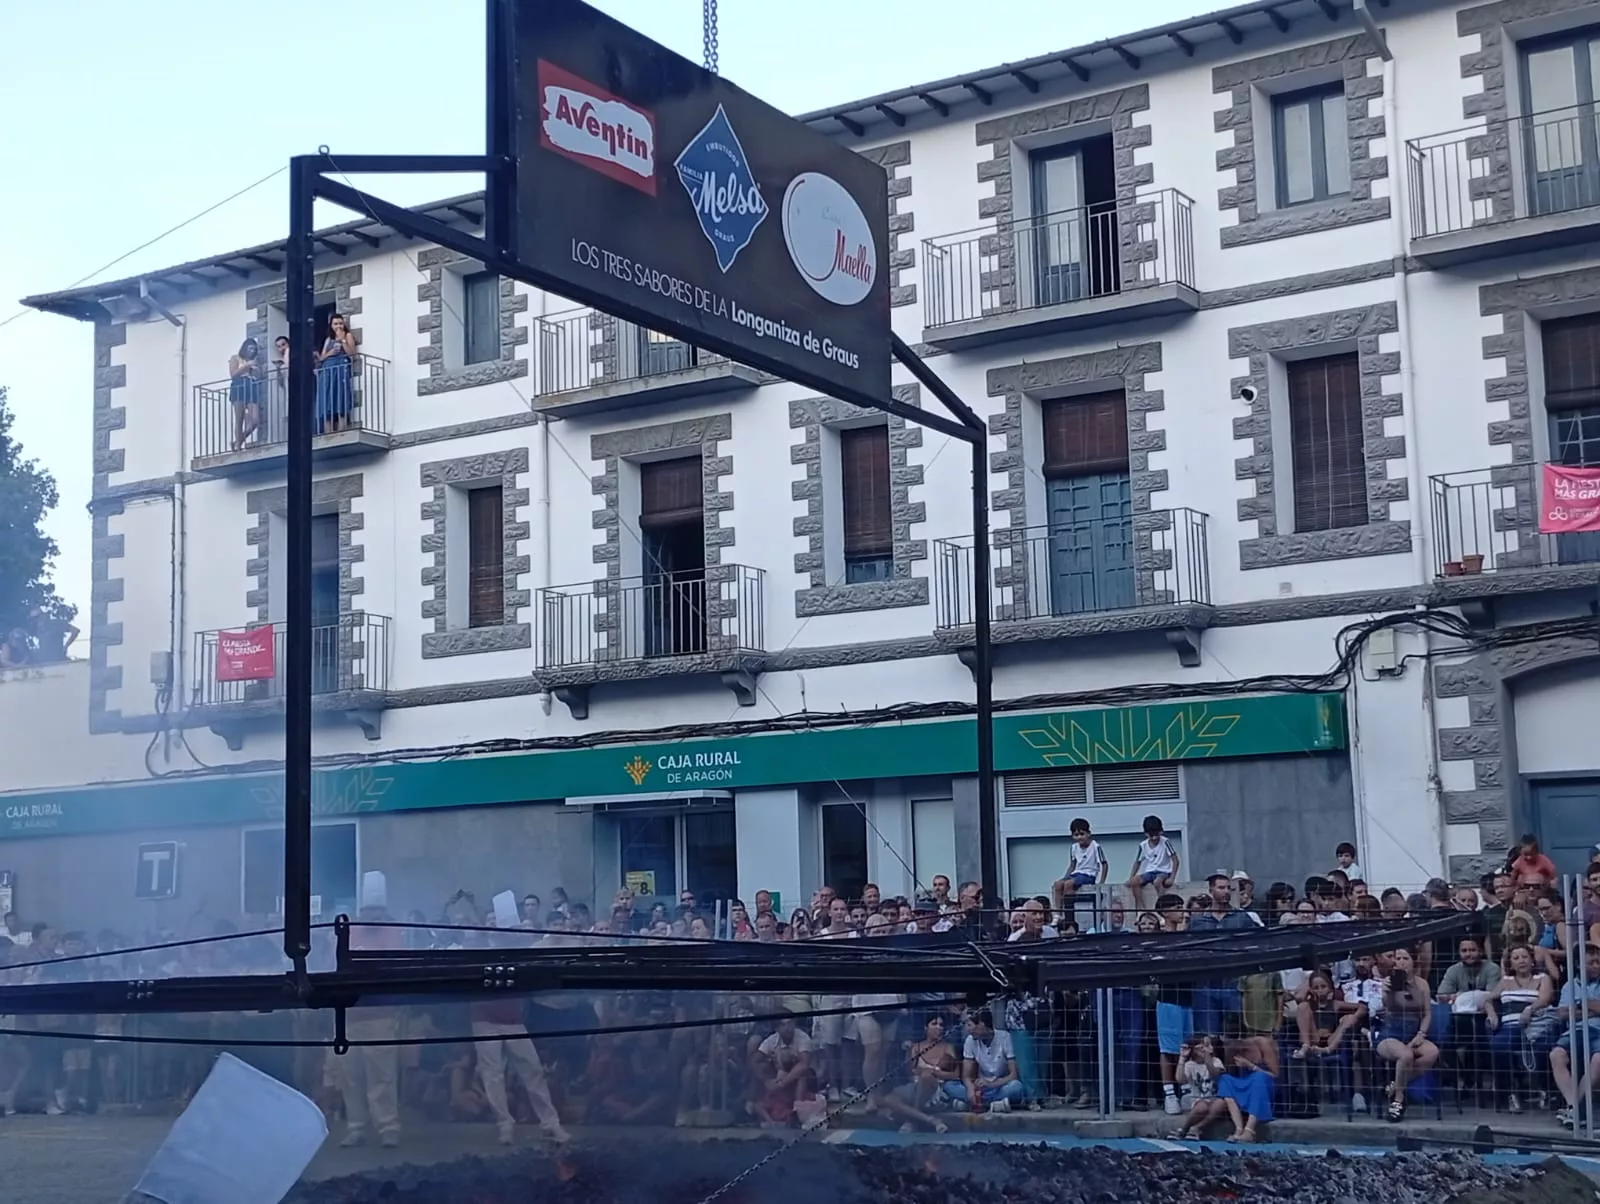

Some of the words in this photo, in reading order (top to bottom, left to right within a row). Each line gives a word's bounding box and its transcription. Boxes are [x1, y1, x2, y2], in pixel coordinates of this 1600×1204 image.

[690, 170, 765, 223] Melsa
[829, 228, 872, 285] Maella
[571, 238, 600, 269] LOS
[601, 249, 632, 281] TRES
[634, 263, 693, 305] SABORES
[694, 287, 711, 313] DE
[713, 294, 729, 319] LA
[731, 300, 801, 347] Longaniza
[802, 330, 820, 354] de
[822, 338, 860, 369] Graus
[657, 754, 692, 770] CAJA
[695, 750, 742, 767] RURAL
[667, 773, 681, 784] DE
[685, 768, 733, 783] ARAGÓN
[5, 805, 30, 818] CAJA
[31, 803, 64, 817] RURAL
